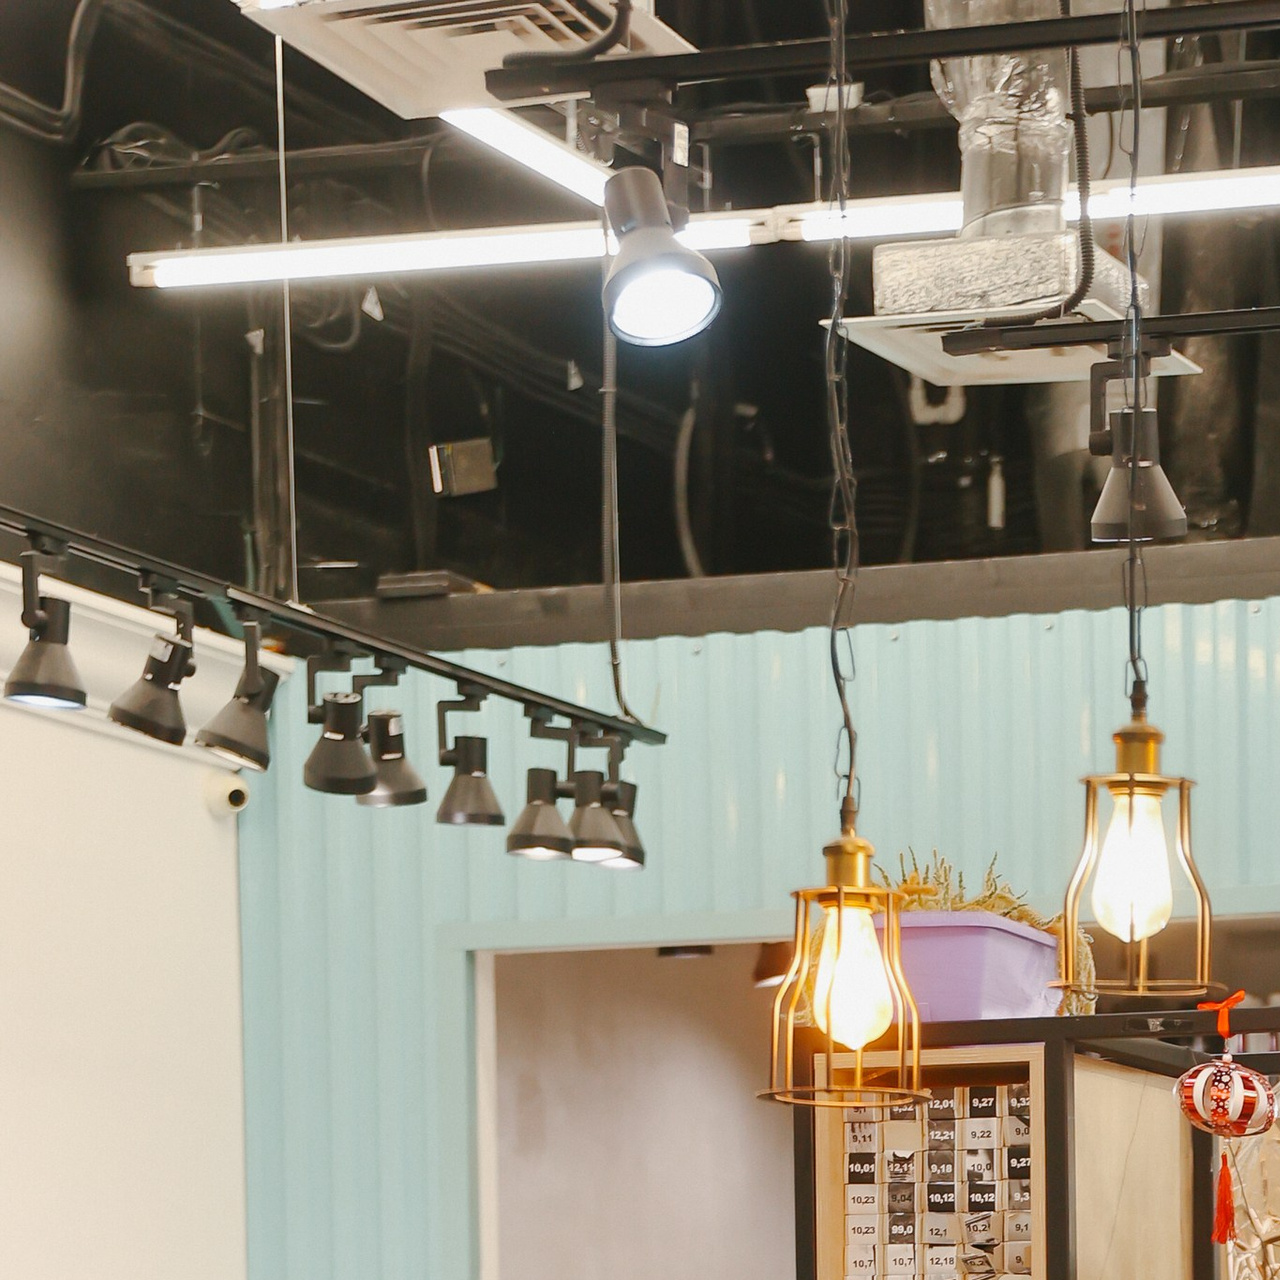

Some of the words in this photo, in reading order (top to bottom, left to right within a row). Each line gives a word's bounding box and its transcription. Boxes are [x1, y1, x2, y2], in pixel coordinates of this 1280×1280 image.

[929, 1099, 954, 1110] 12,01
[972, 1098, 994, 1107] 9,27
[852, 1134, 872, 1143] 9,11
[930, 1131, 954, 1141] 12,21
[971, 1131, 992, 1139] 9,22
[1010, 1158, 1030, 1167] 9,27
[849, 1164, 875, 1173] 10,01
[930, 1164, 952, 1174] 9,18
[851, 1196, 875, 1204] 10,23
[929, 1193, 954, 1203] 10,12
[970, 1193, 995, 1203] 10,12
[852, 1227, 875, 1235] 10,23
[892, 1226, 913, 1234] 99,0
[930, 1228, 947, 1236] 12,1
[1015, 1224, 1029, 1232] 9,1
[853, 1260, 873, 1268] 10,7
[893, 1258, 913, 1266] 10,7
